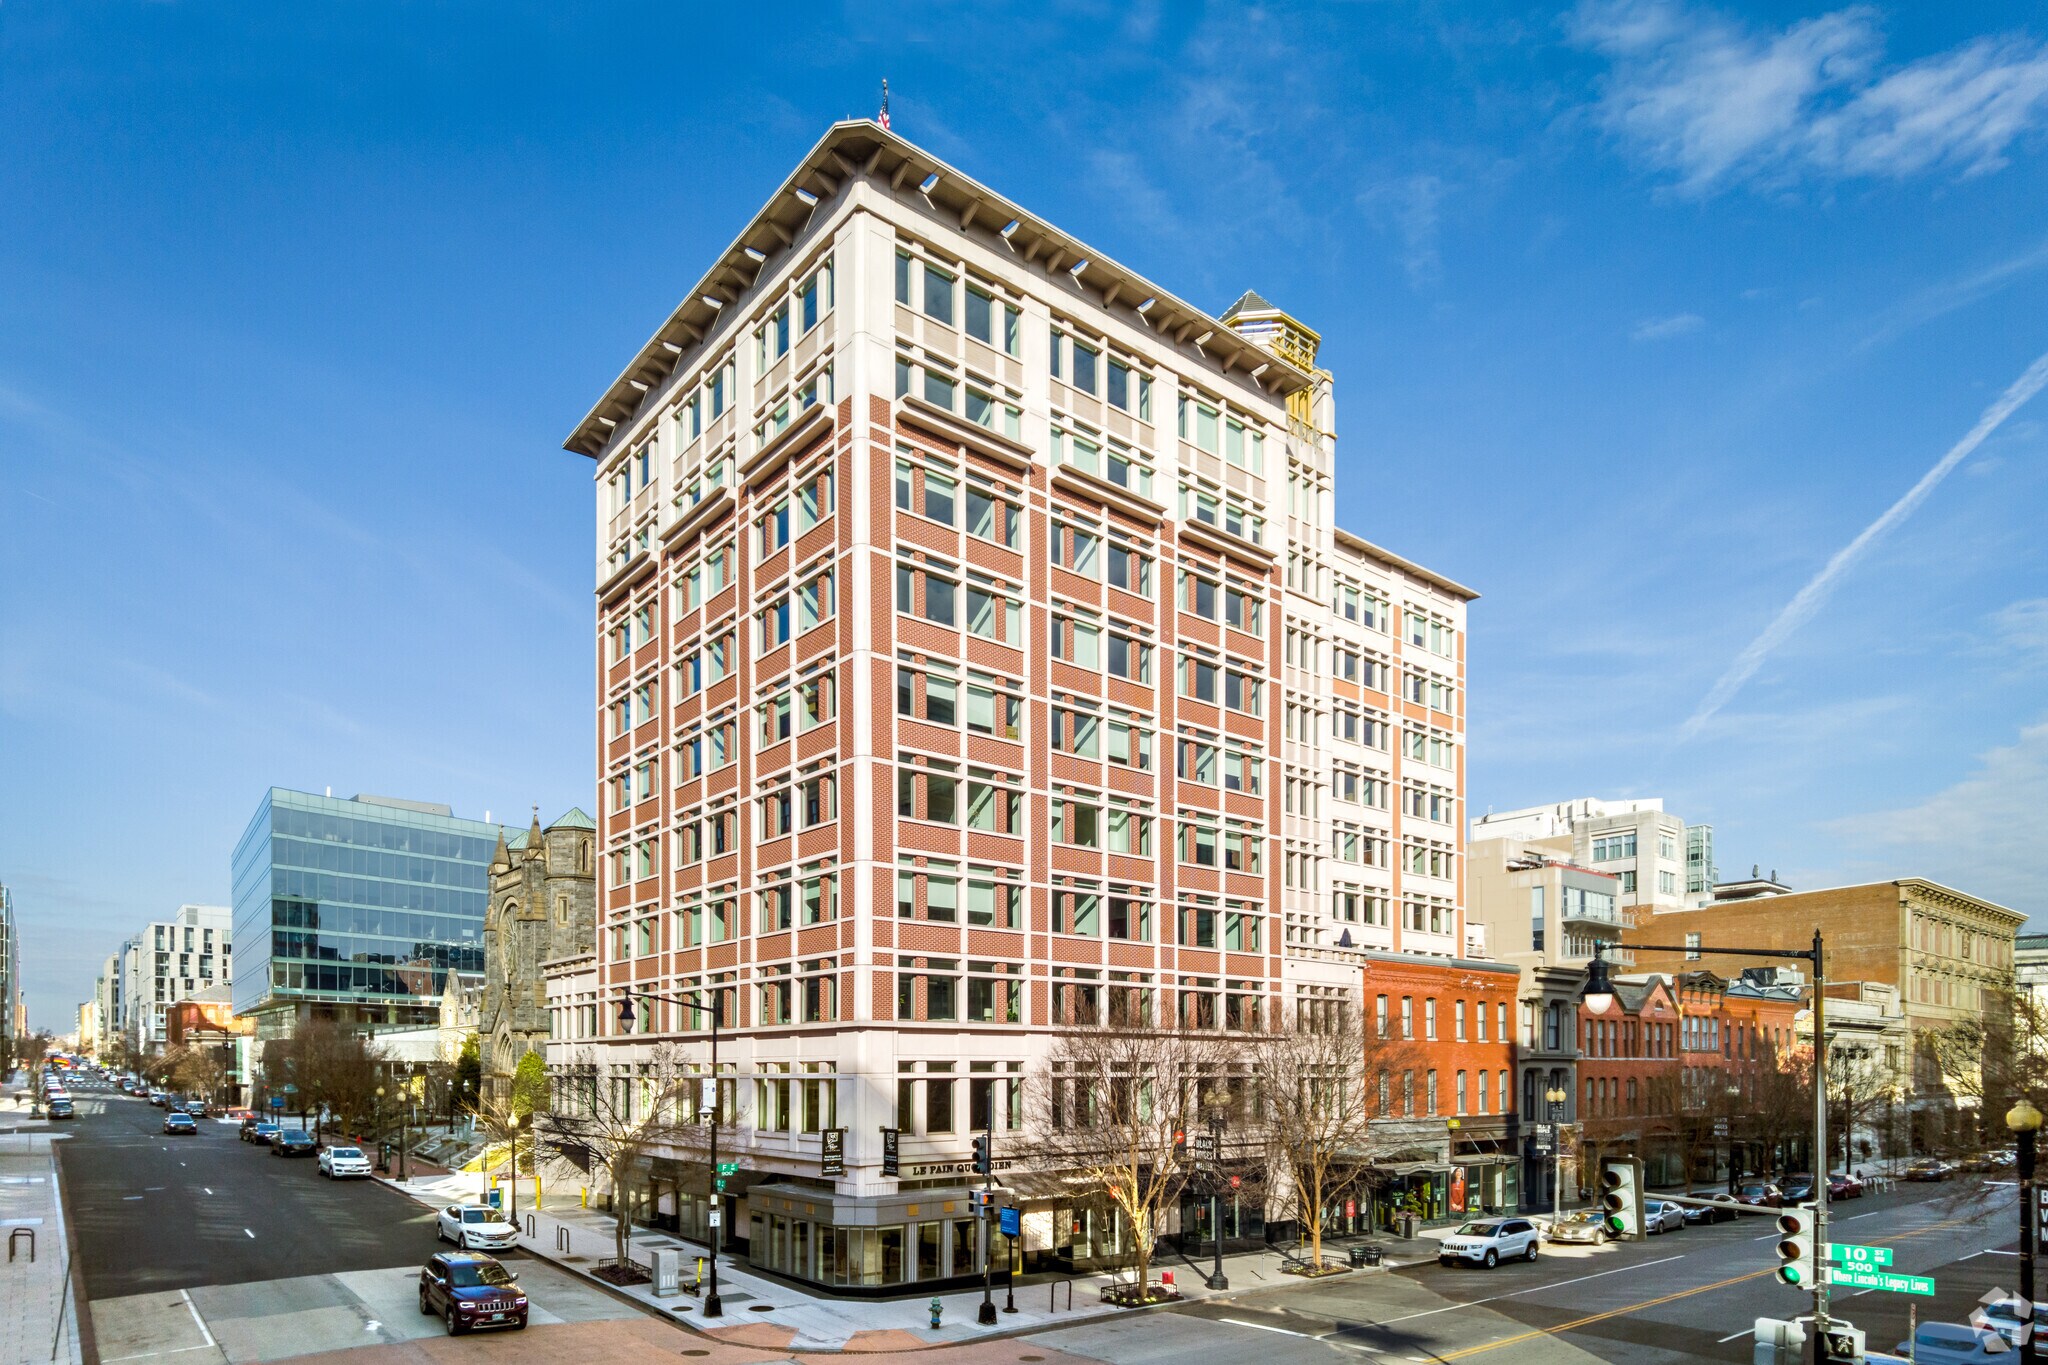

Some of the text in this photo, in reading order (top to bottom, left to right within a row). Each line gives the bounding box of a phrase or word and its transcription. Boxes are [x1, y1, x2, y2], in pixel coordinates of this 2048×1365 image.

[1196, 1139, 1213, 1149] BLACK
[913, 1161, 1012, 1175] LE PAIN QUDIEN
[1844, 1247, 1867, 1261] 10
[1847, 1262, 1873, 1272] 500
[1833, 1269, 1929, 1292] Where Lincoln's Legacy Lives
